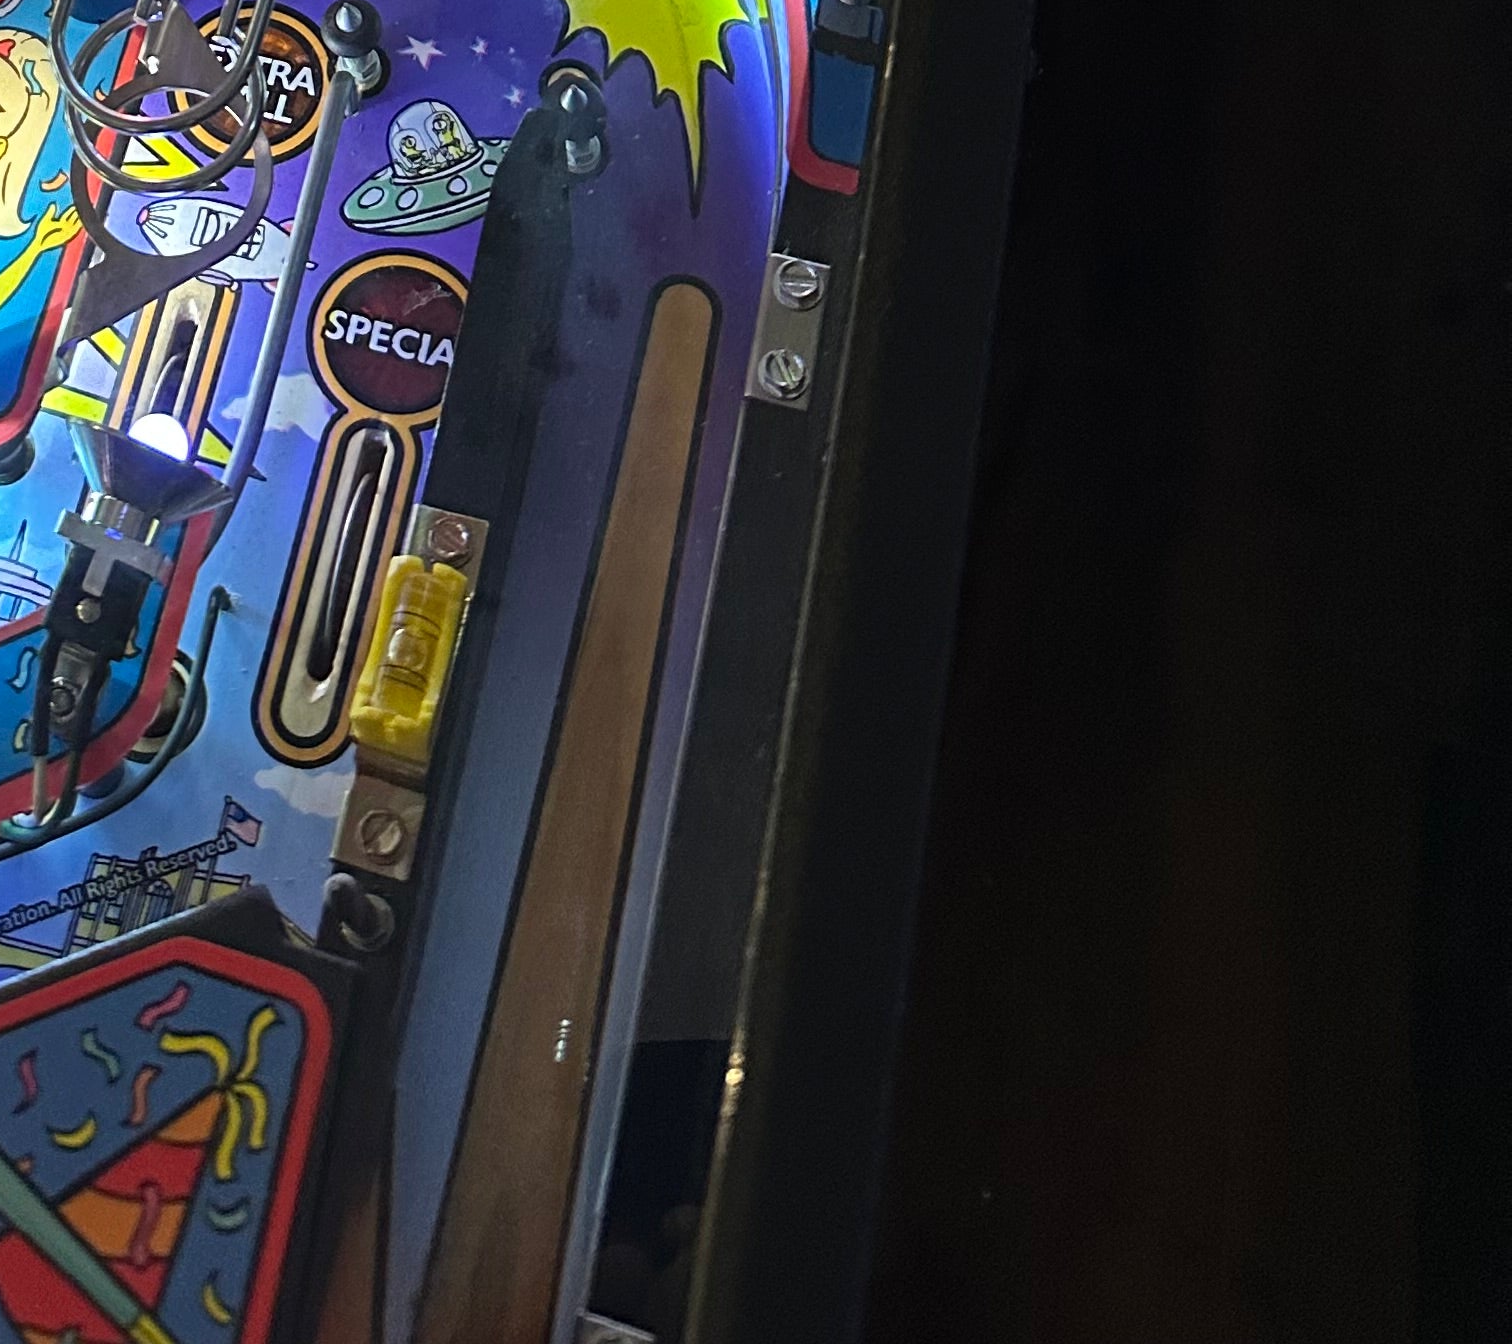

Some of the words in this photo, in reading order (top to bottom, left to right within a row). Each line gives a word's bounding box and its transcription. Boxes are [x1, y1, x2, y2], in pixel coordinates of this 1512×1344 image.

[324, 309, 456, 367] SPECIA
[58, 887, 86, 909] All
[86, 866, 144, 900] Rights
[145, 836, 238, 878] Reserved.
